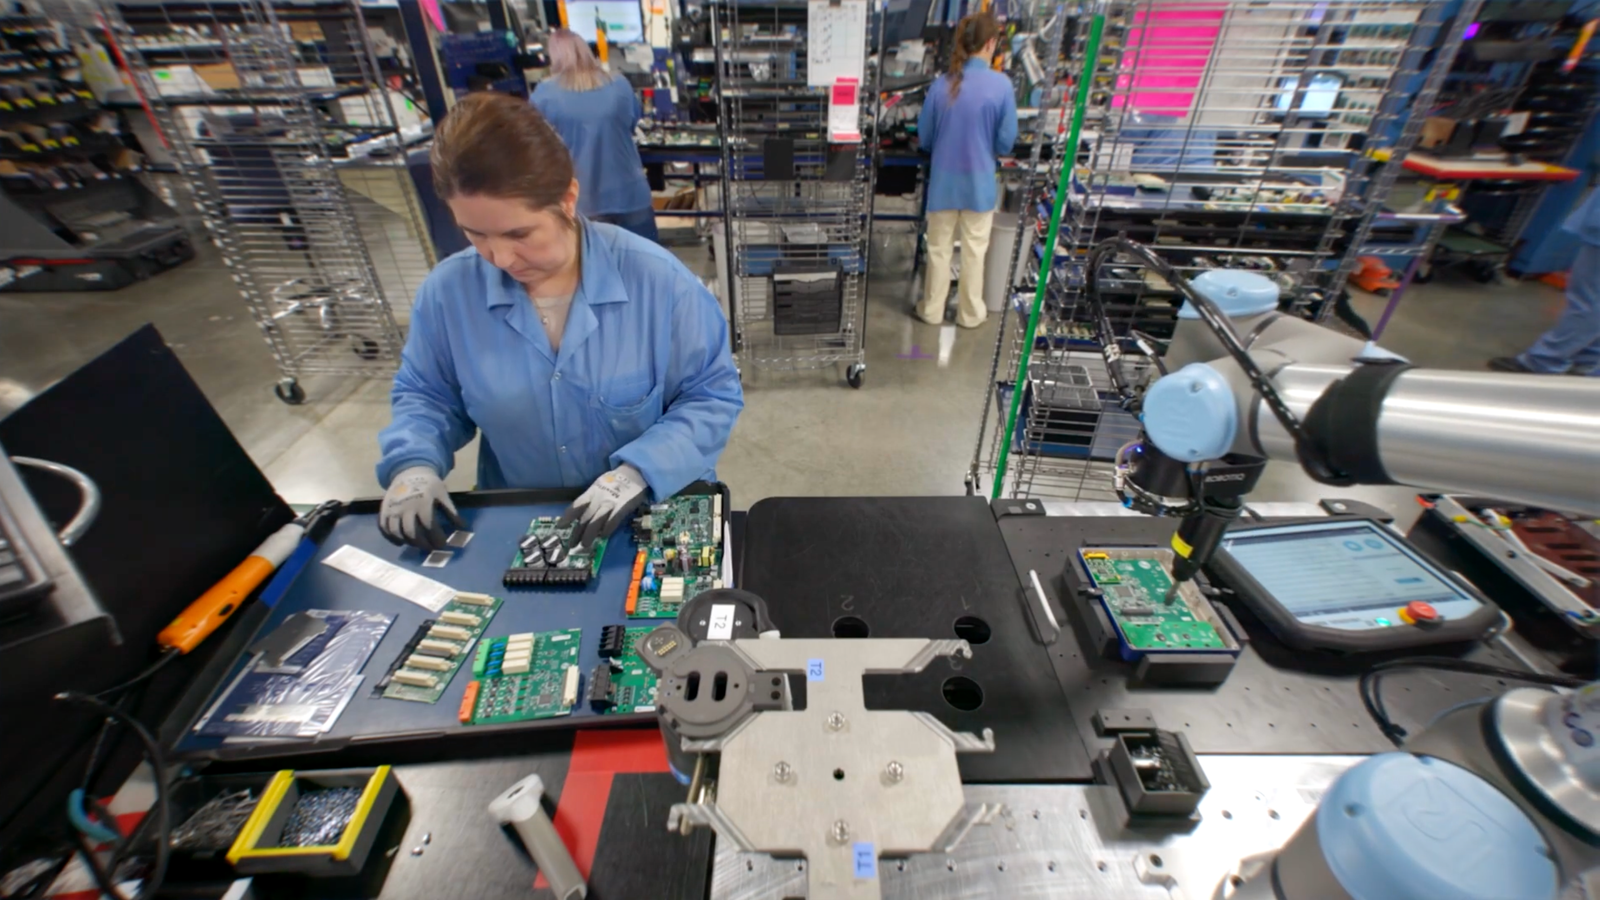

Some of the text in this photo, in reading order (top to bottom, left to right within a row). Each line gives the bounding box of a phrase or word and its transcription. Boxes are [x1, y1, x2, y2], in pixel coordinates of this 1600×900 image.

[714, 615, 727, 629] T2
[810, 662, 822, 676] T2
[857, 852, 871, 871] T1
